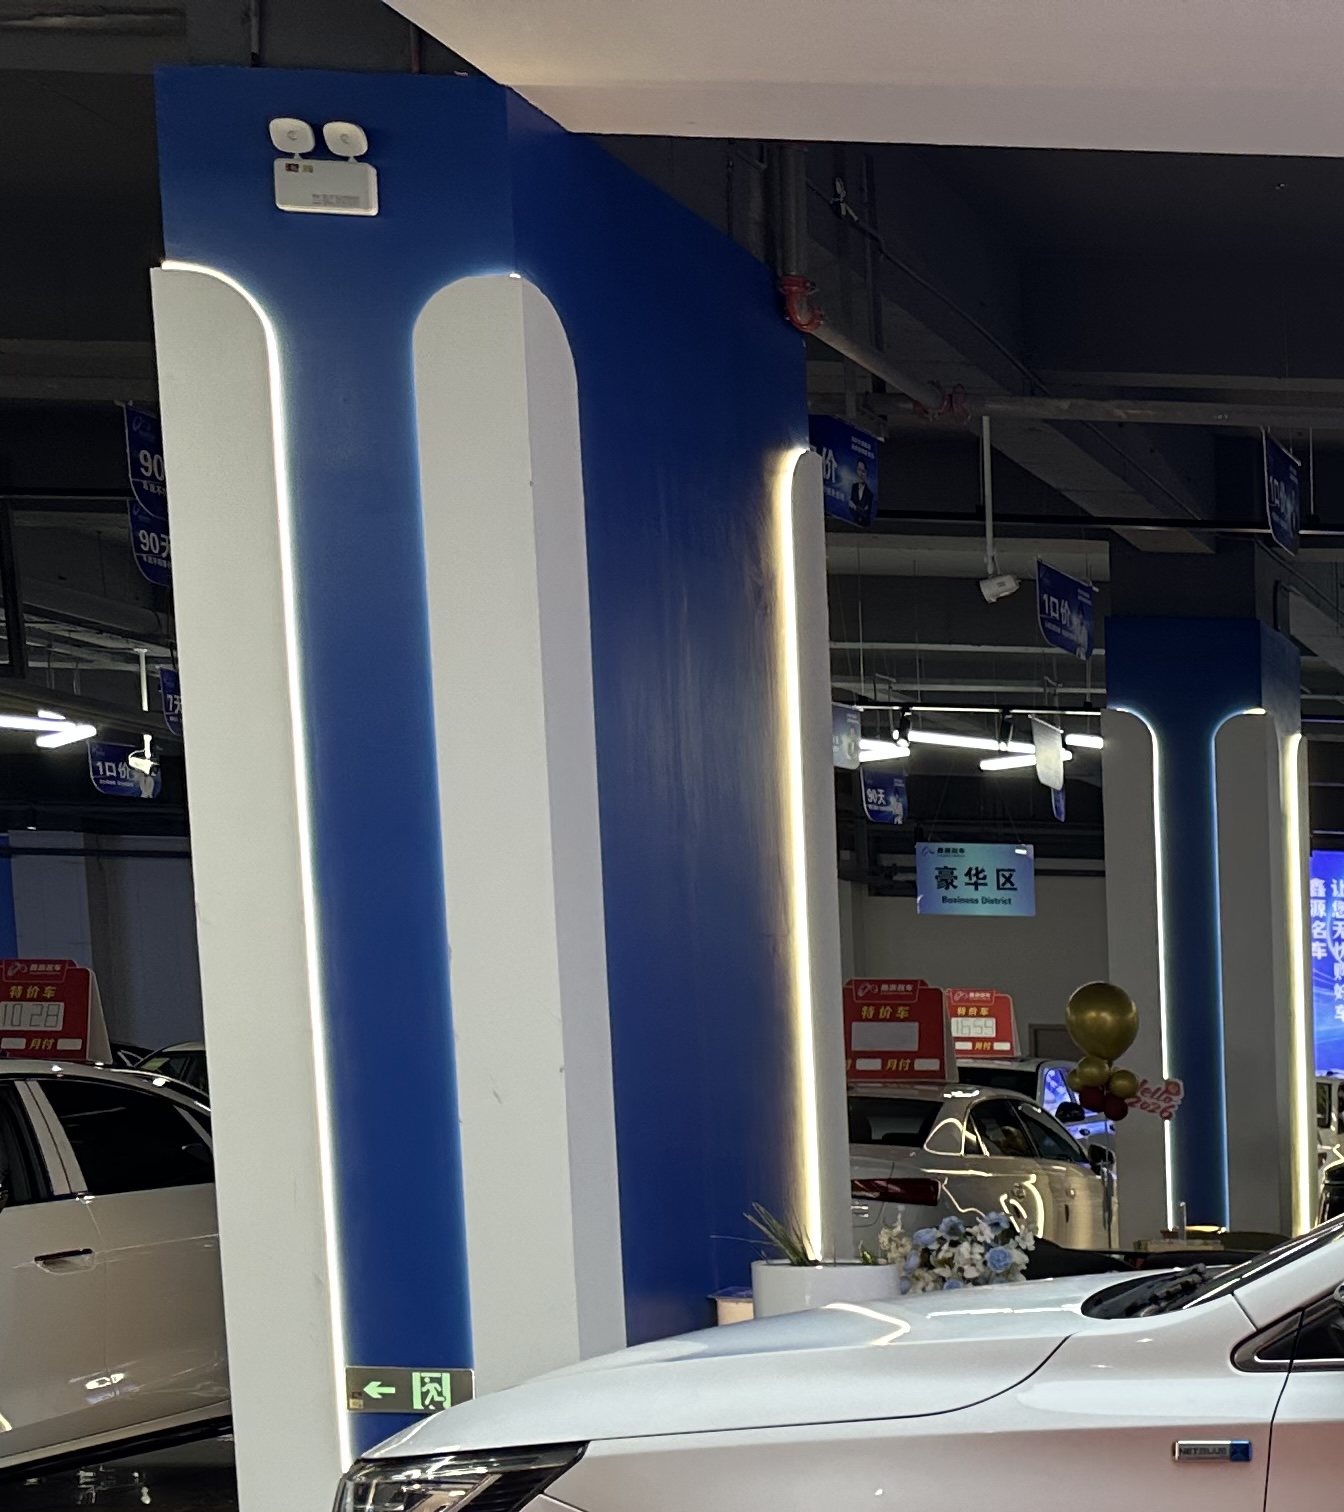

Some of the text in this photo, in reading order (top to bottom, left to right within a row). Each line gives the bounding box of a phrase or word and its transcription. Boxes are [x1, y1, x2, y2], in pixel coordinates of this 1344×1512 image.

[1043, 594, 1071, 628] 1口价
[934, 865, 1018, 891] 豪华区
[942, 896, 1012, 905] Business District
[1309, 878, 1328, 960] 鑫源名车
[9, 985, 57, 998] 特价车
[861, 1006, 911, 1019] 特价车
